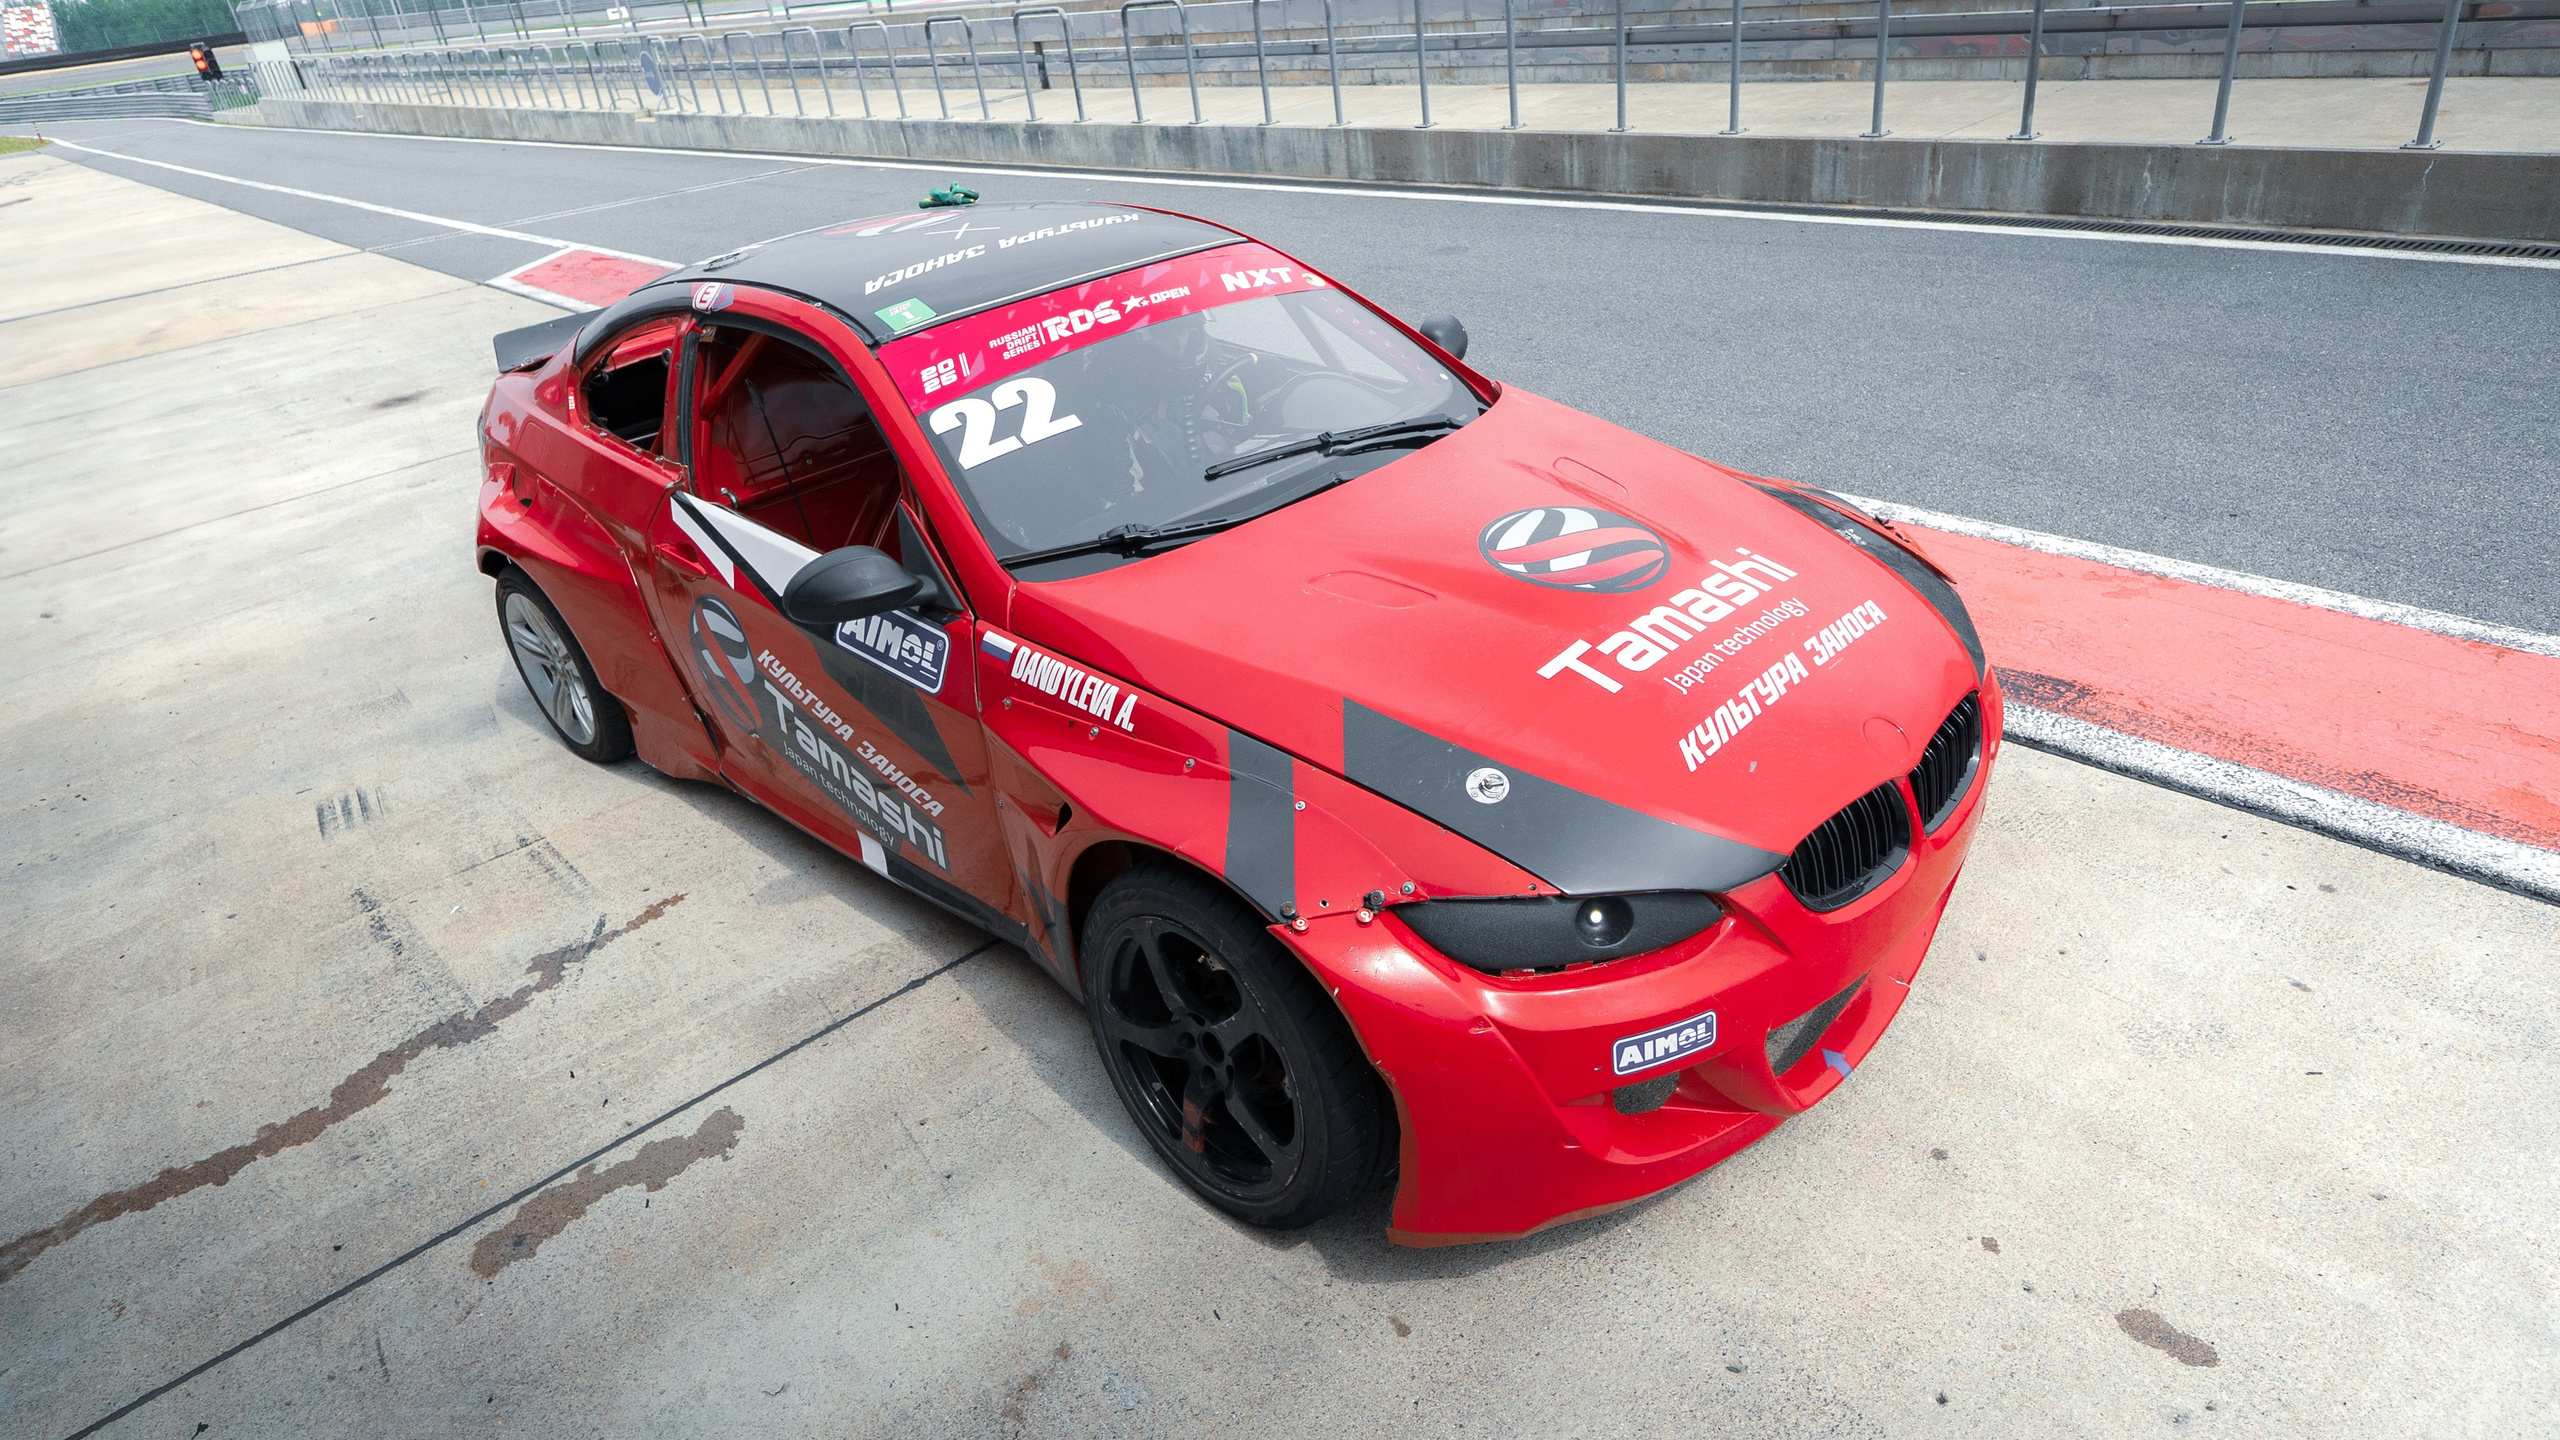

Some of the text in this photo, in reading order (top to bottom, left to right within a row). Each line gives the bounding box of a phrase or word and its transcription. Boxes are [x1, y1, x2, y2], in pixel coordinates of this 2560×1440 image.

[865, 213, 1139, 295] КУЛЬТУРА ЗАНОСА
[1220, 267, 1292, 292] NXT
[988, 325, 1037, 349] RUSSIAN
[1002, 340, 1041, 360] SERIES
[1006, 334, 1038, 350] DRIFT
[1042, 286, 1191, 342] RDS OPEN
[929, 377, 1083, 471] 22
[841, 614, 939, 680] AIMOL
[1536, 546, 1799, 695] Tamashi
[1662, 597, 1811, 696] Japan technology
[1010, 645, 1139, 733] DANDYLEVA A.
[1677, 599, 1889, 773] КУЛЬТУРА ЗАНОСА
[756, 649, 945, 818] КУЛЬТУРА ЗАНОСА
[763, 679, 947, 870] Tamashi
[782, 740, 895, 847] Japan technology
[1618, 1021, 1712, 1069] AIMOL
